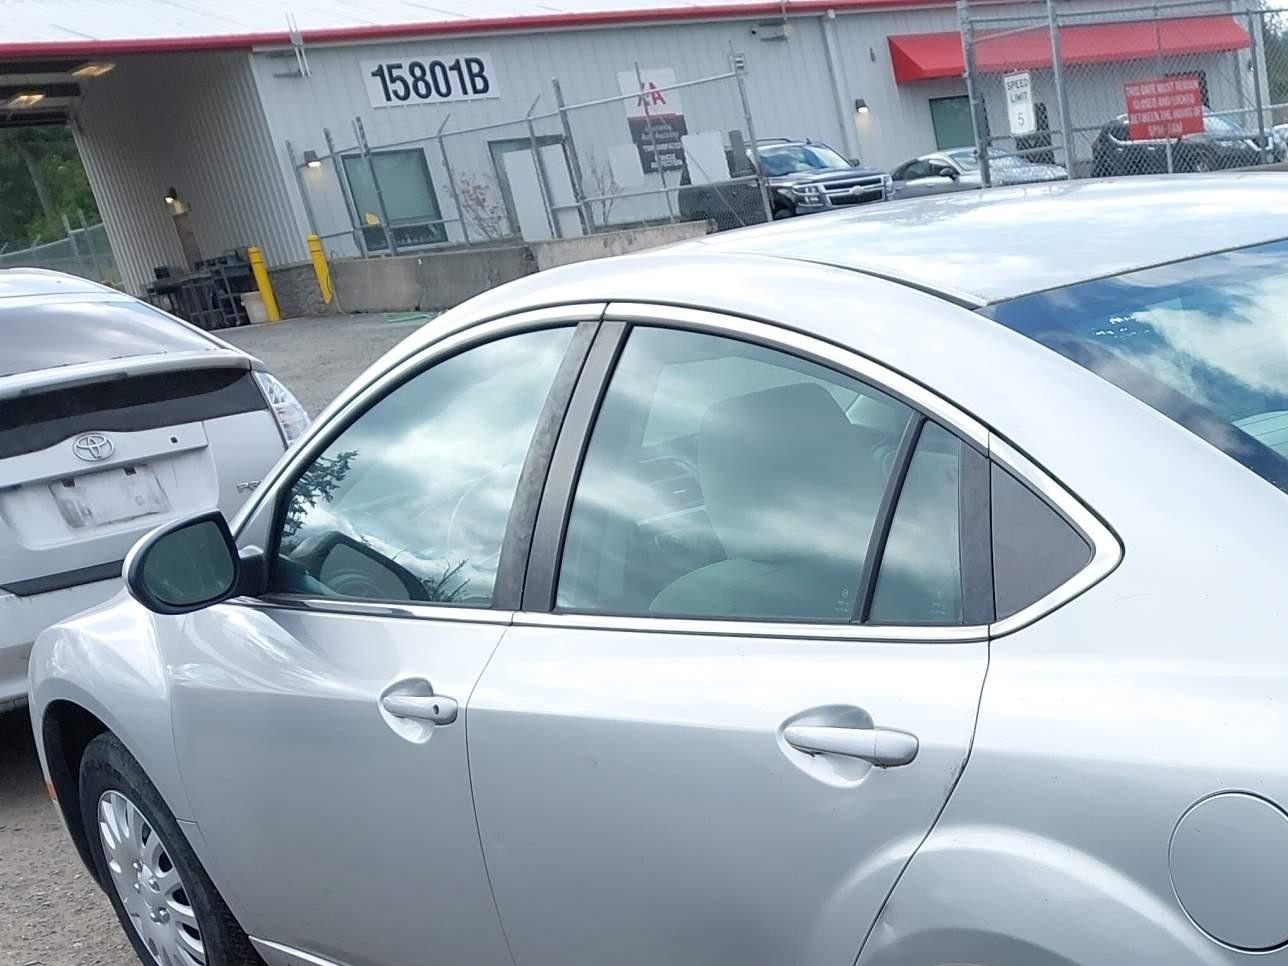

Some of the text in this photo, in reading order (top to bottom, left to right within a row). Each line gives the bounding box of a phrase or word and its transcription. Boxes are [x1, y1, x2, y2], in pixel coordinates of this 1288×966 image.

[371, 57, 490, 102] 15801B
[1006, 78, 1029, 91] SPEED
[1010, 91, 1029, 104] LIMIT
[1017, 112, 1025, 126] 5
